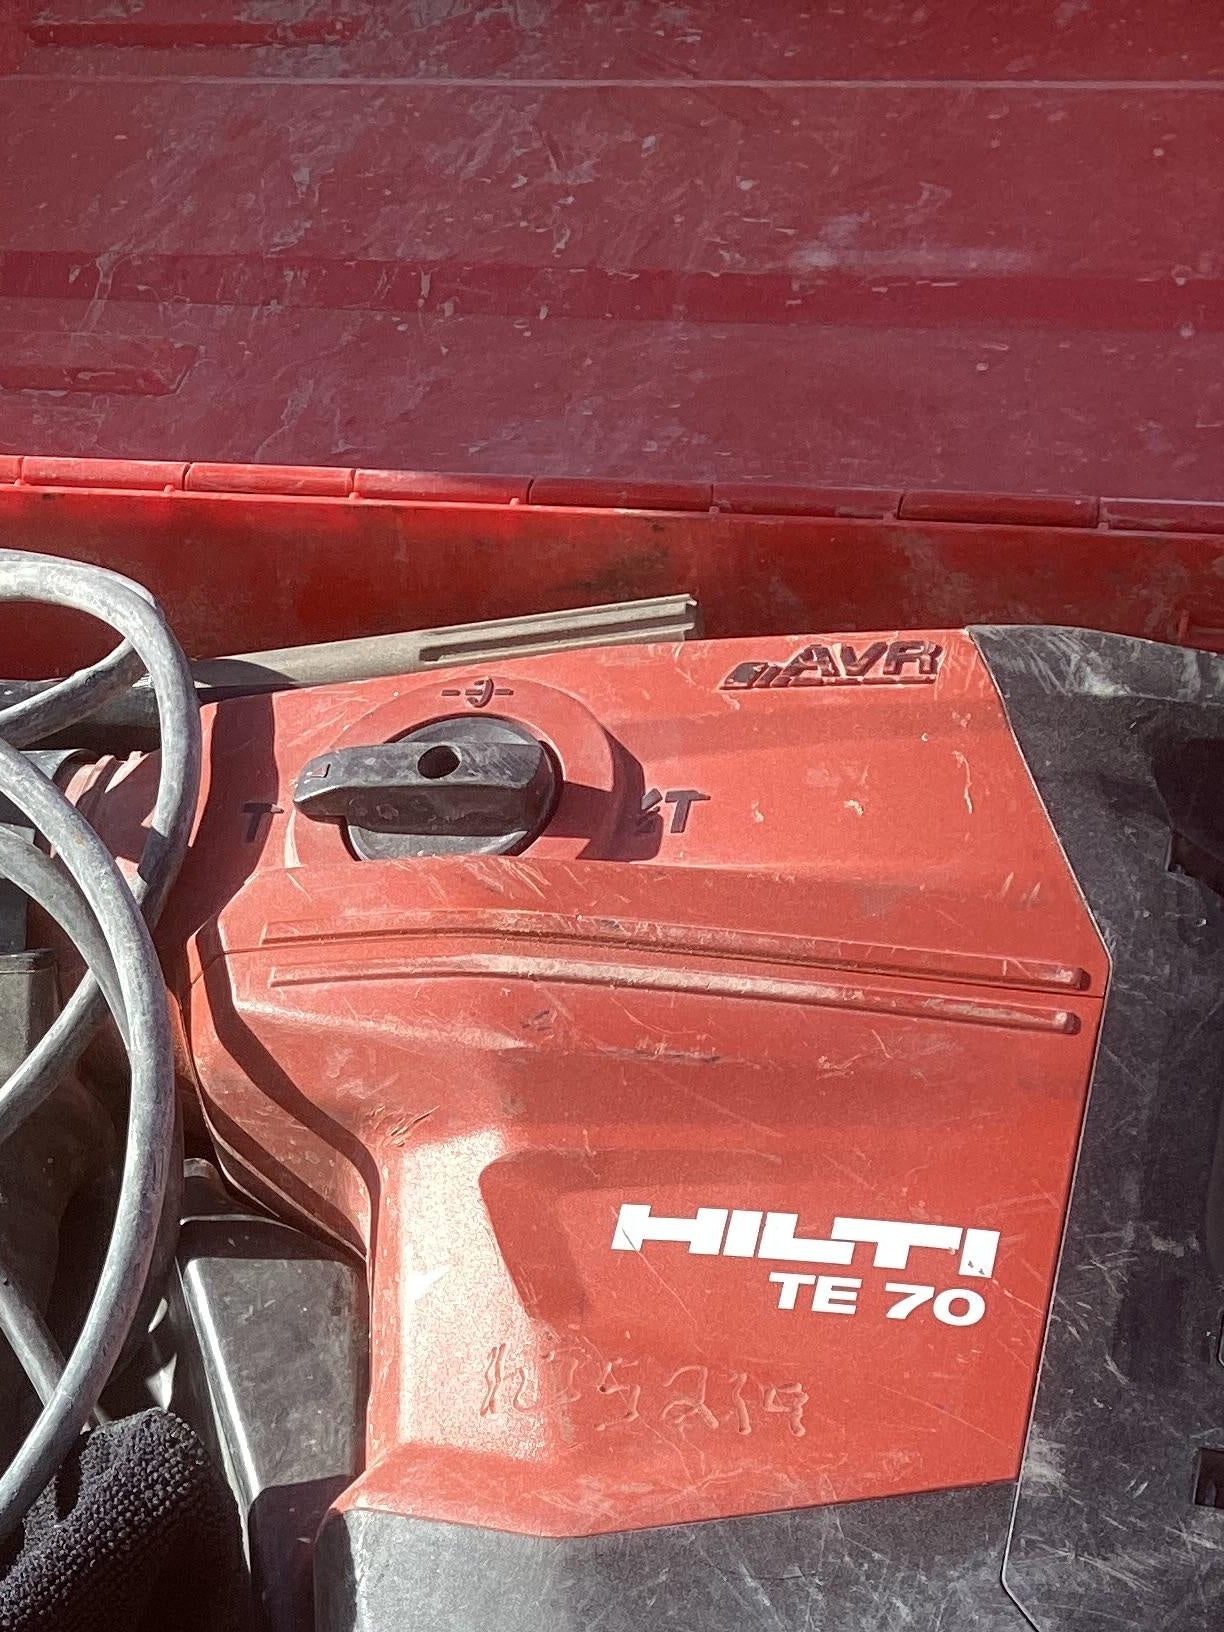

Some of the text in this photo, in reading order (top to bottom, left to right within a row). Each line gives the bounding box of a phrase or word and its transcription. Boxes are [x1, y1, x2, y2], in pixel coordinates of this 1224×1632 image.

[778, 640, 944, 678] AVR
[611, 1203, 1001, 1279] HILTI
[768, 1271, 986, 1327] TE 70
